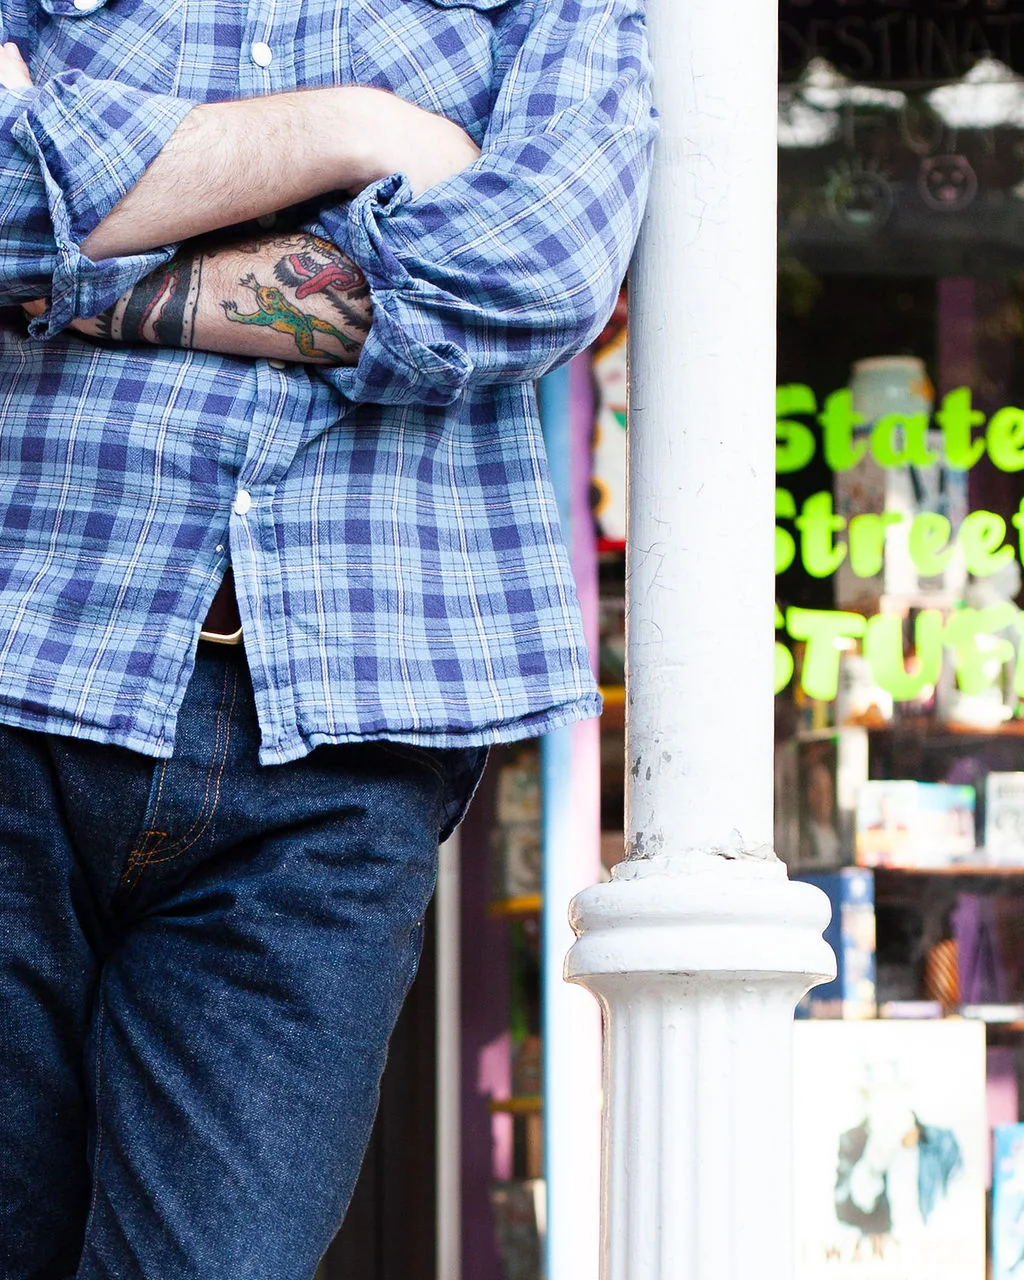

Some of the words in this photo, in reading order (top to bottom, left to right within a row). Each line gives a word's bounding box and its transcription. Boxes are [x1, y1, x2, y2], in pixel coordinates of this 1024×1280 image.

[775, 383, 1024, 472] State
[775, 487, 1024, 578] tree
[775, 601, 1024, 701] TUF
